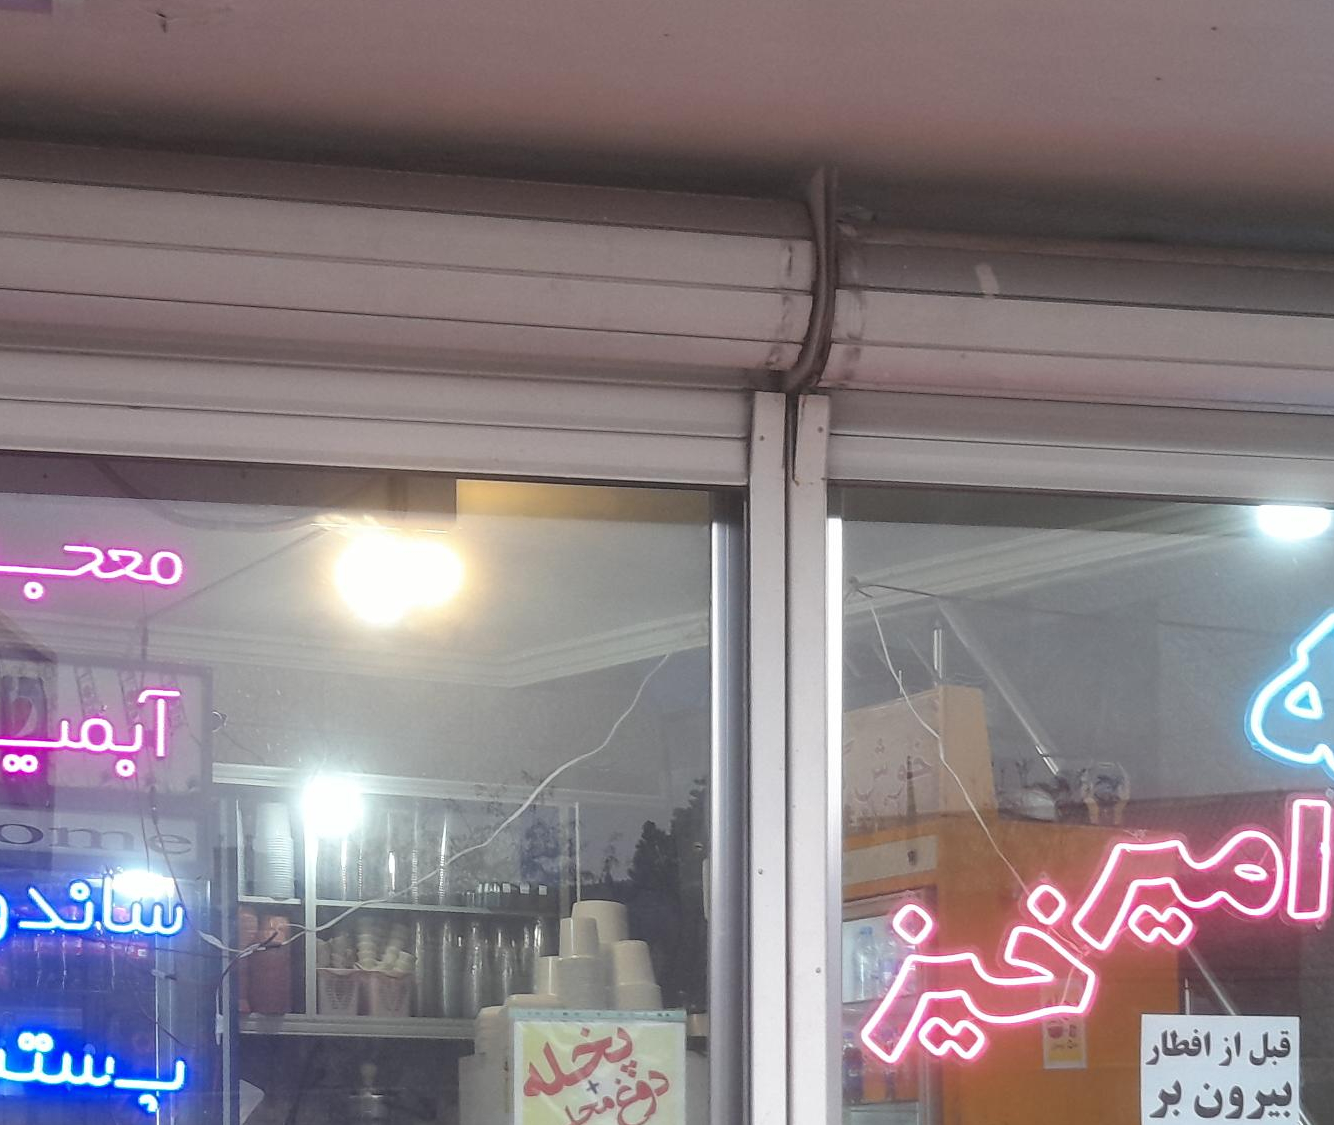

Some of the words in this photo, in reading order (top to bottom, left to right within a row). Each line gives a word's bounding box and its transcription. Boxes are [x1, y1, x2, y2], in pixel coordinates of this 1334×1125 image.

[523, 1026, 638, 1097] پخله
[1145, 1028, 1212, 1066] افطار
[1218, 1030, 1242, 1067] از
[1249, 1030, 1292, 1066] قبل
[1149, 1079, 1183, 1119] بر
[1194, 1080, 1293, 1120] بیرون
